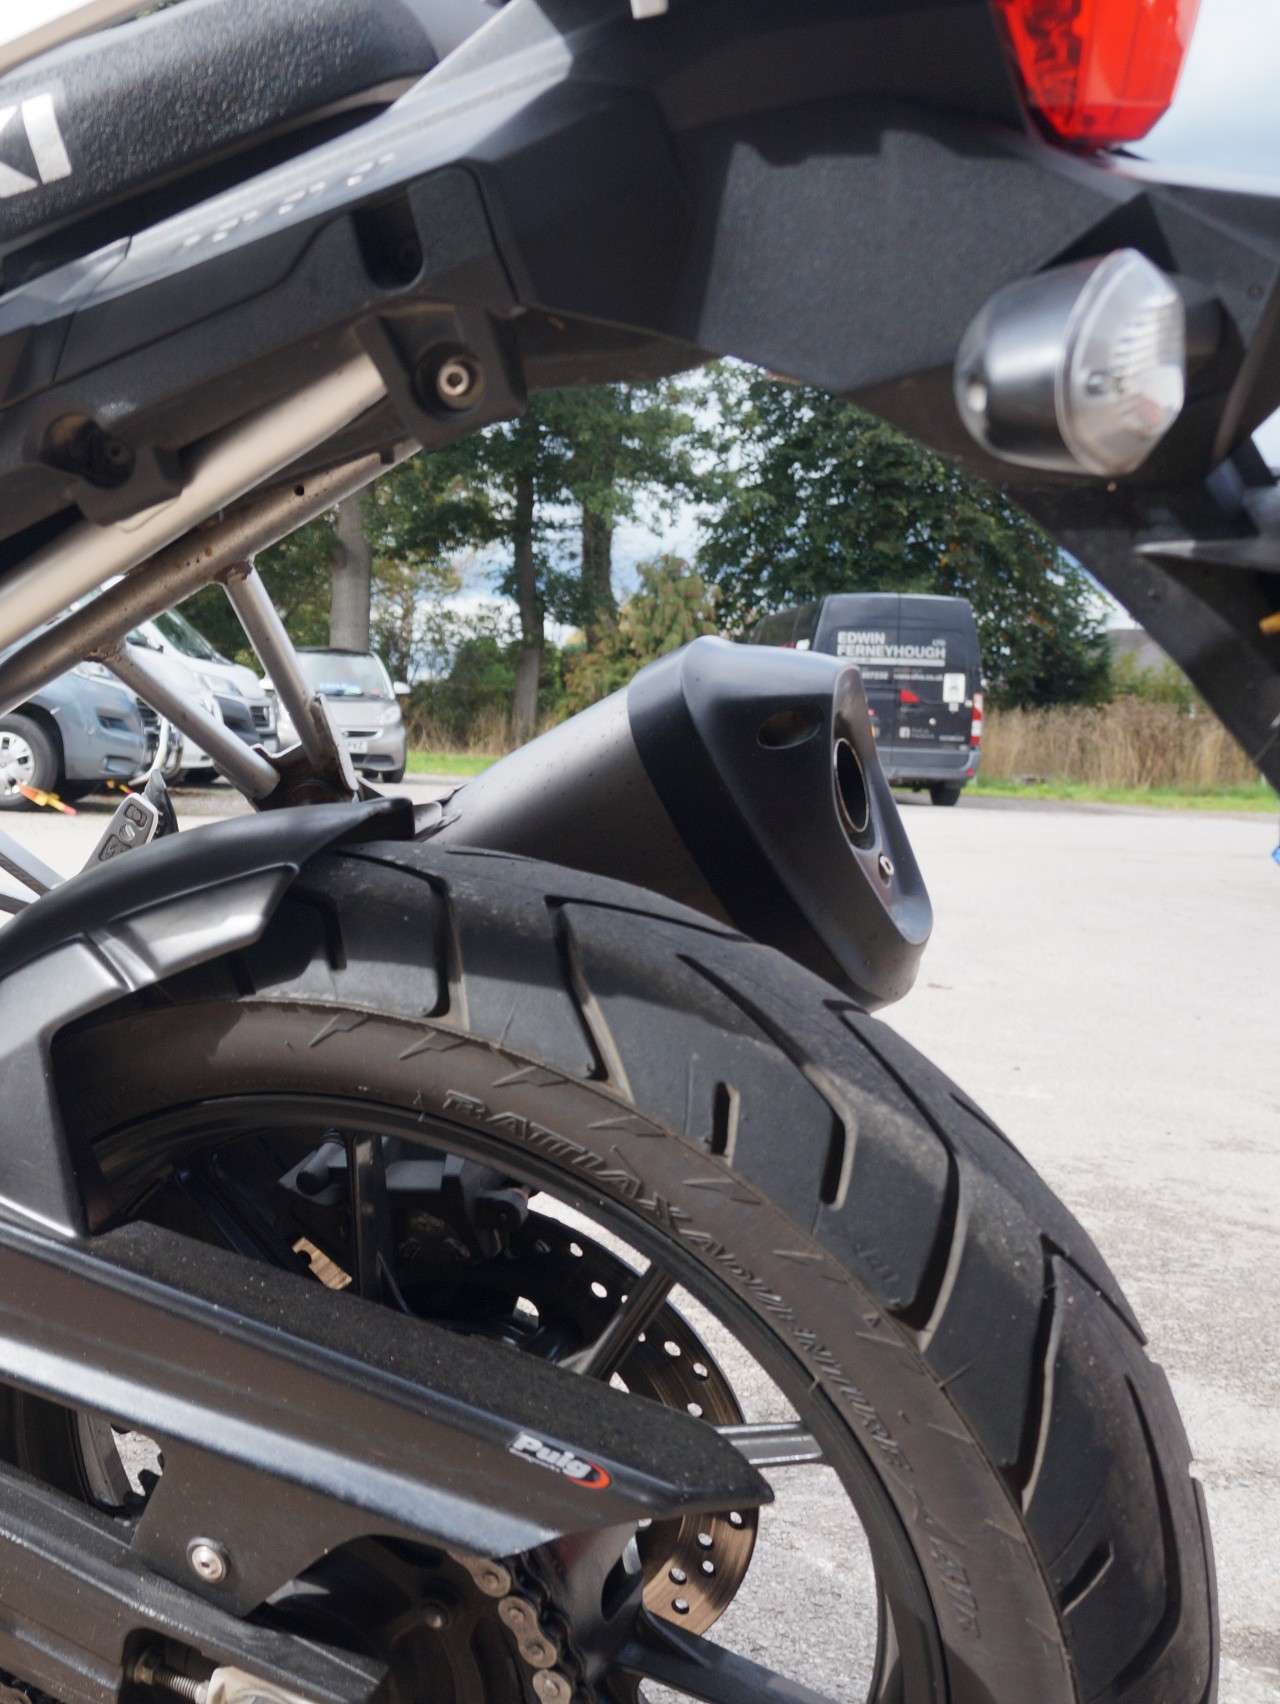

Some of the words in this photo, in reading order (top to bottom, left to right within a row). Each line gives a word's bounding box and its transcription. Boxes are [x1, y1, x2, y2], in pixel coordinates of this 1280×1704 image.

[837, 631, 885, 644] EDWIN
[837, 645, 946, 658] FERNEYHOUGH
[512, 1433, 592, 1479] Puig
